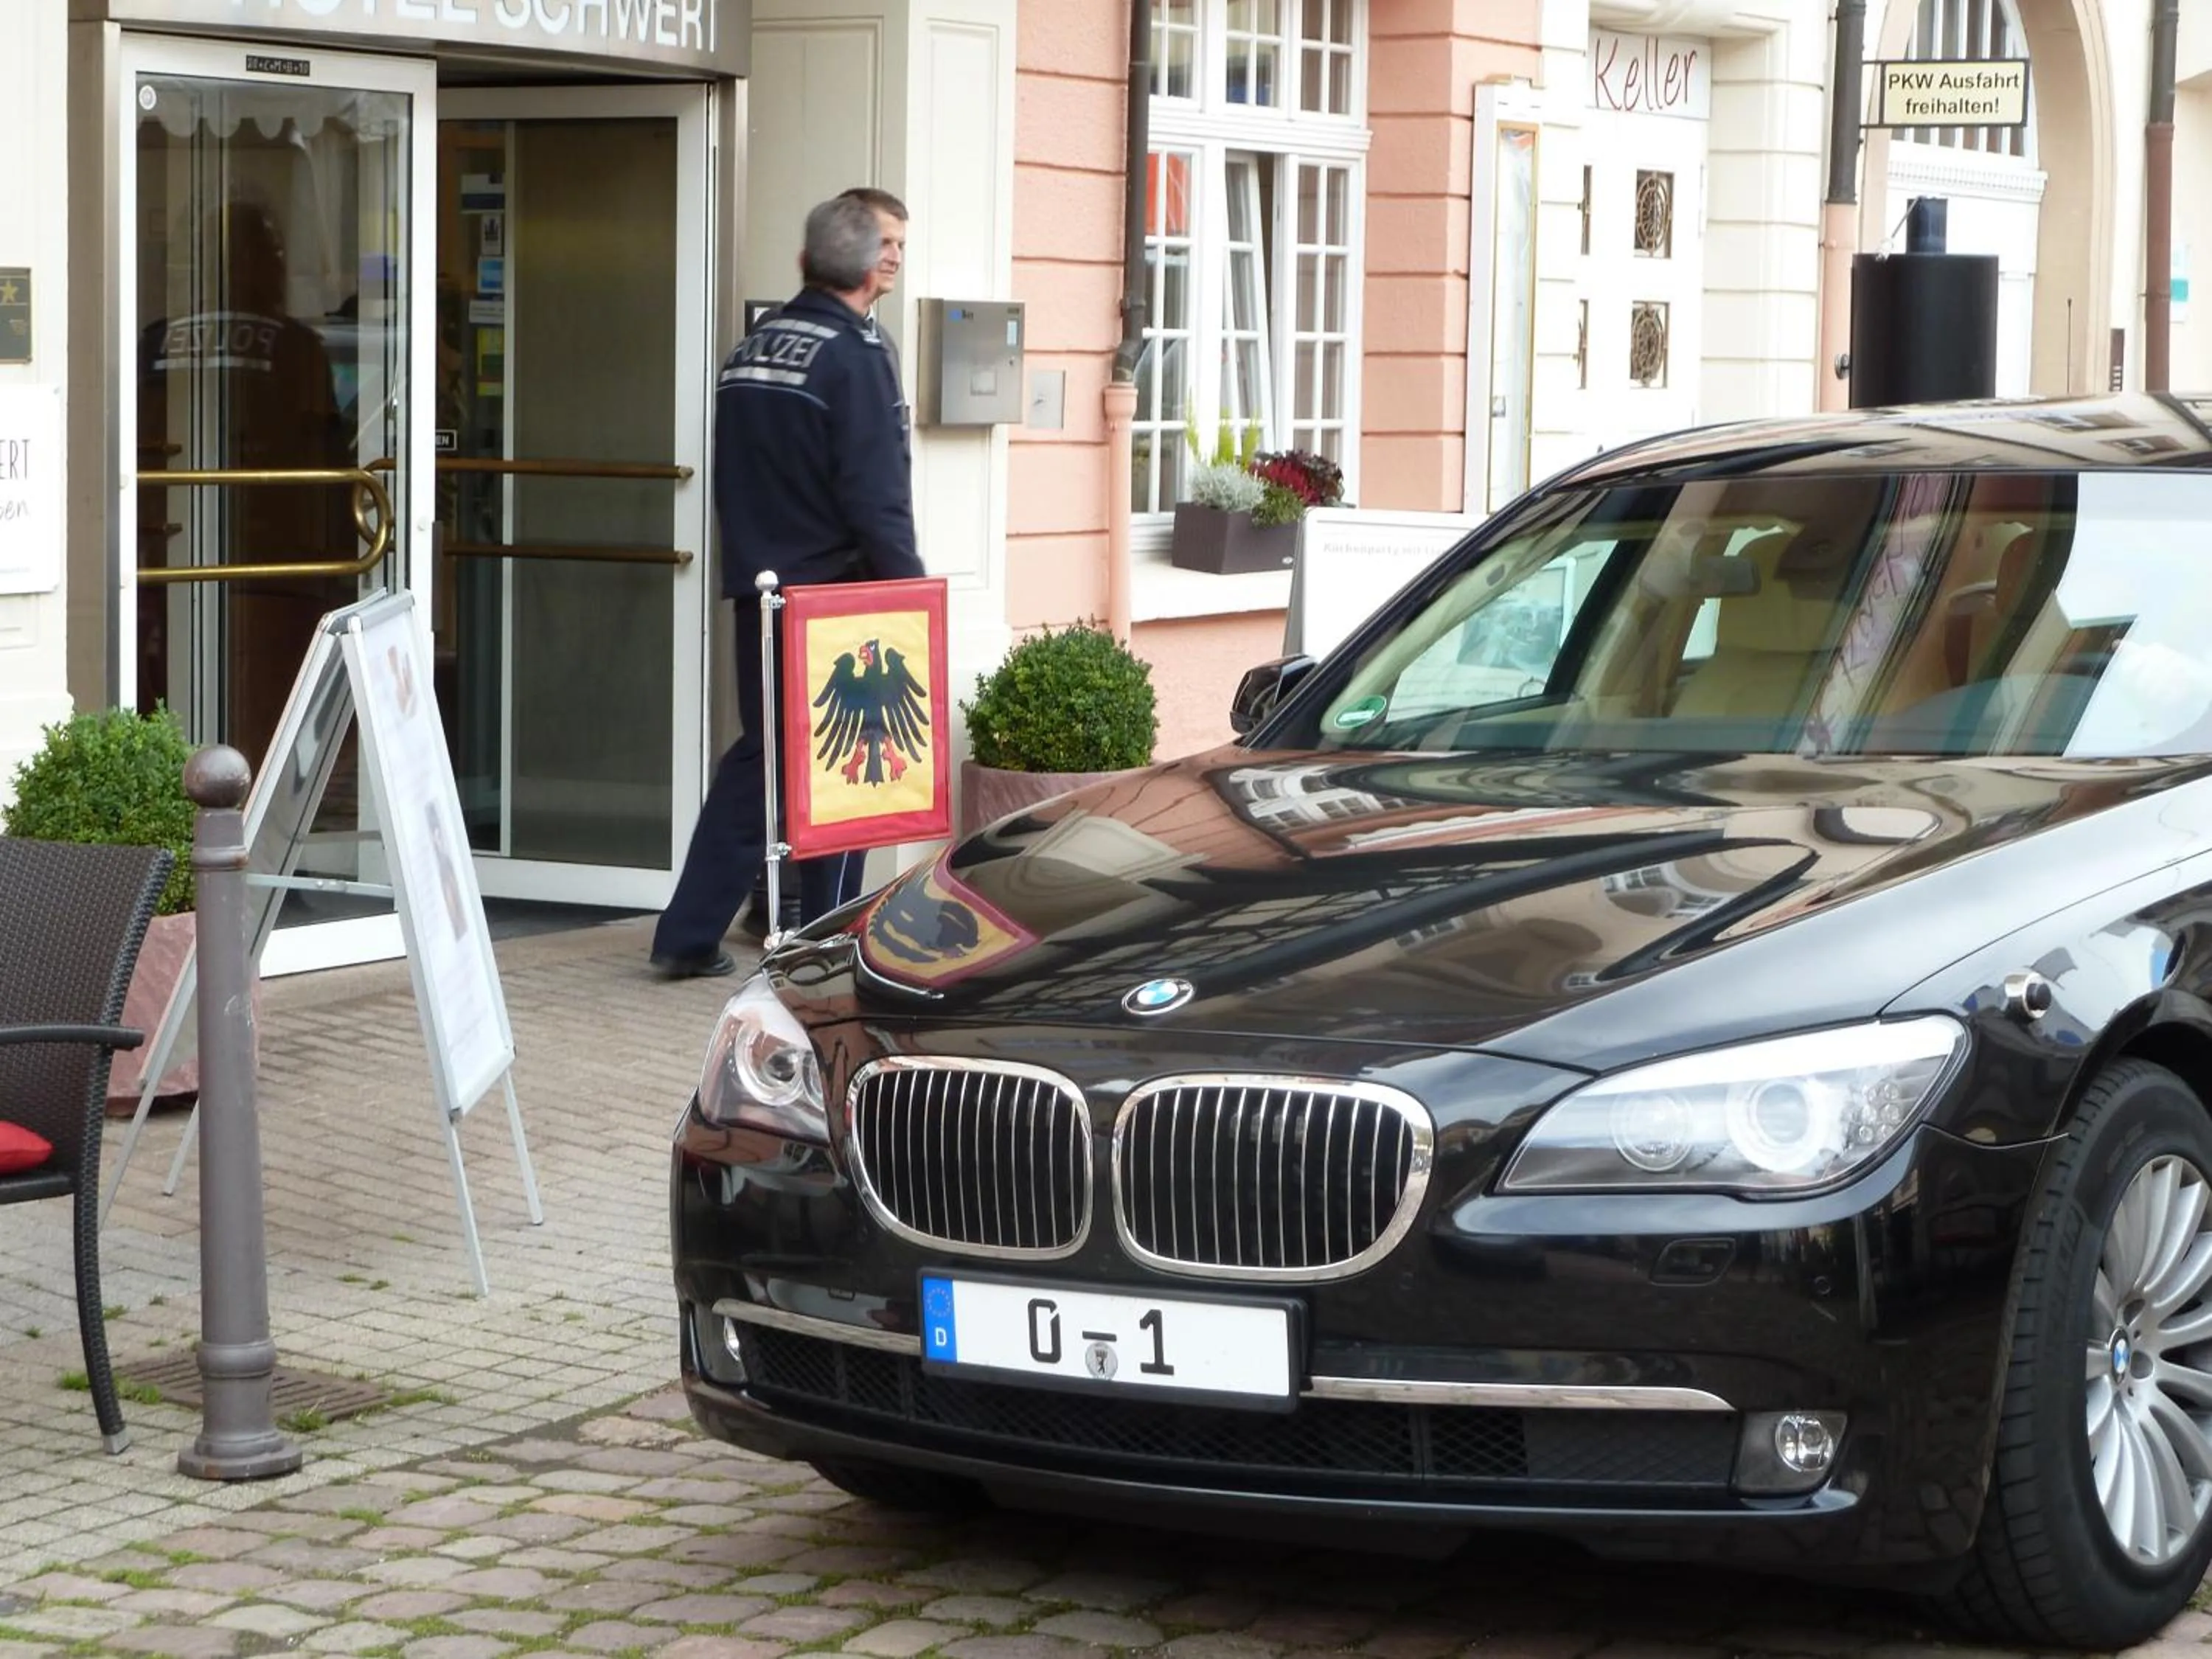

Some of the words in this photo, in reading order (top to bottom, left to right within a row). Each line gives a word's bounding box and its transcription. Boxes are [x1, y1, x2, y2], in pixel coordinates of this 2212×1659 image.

[1595, 35, 1697, 111] Keller
[1888, 74, 1933, 89] PKW
[1939, 72, 2020, 89] Ausfahrt
[1906, 97, 2000, 114] freihalten!
[935, 1328, 947, 1347] D
